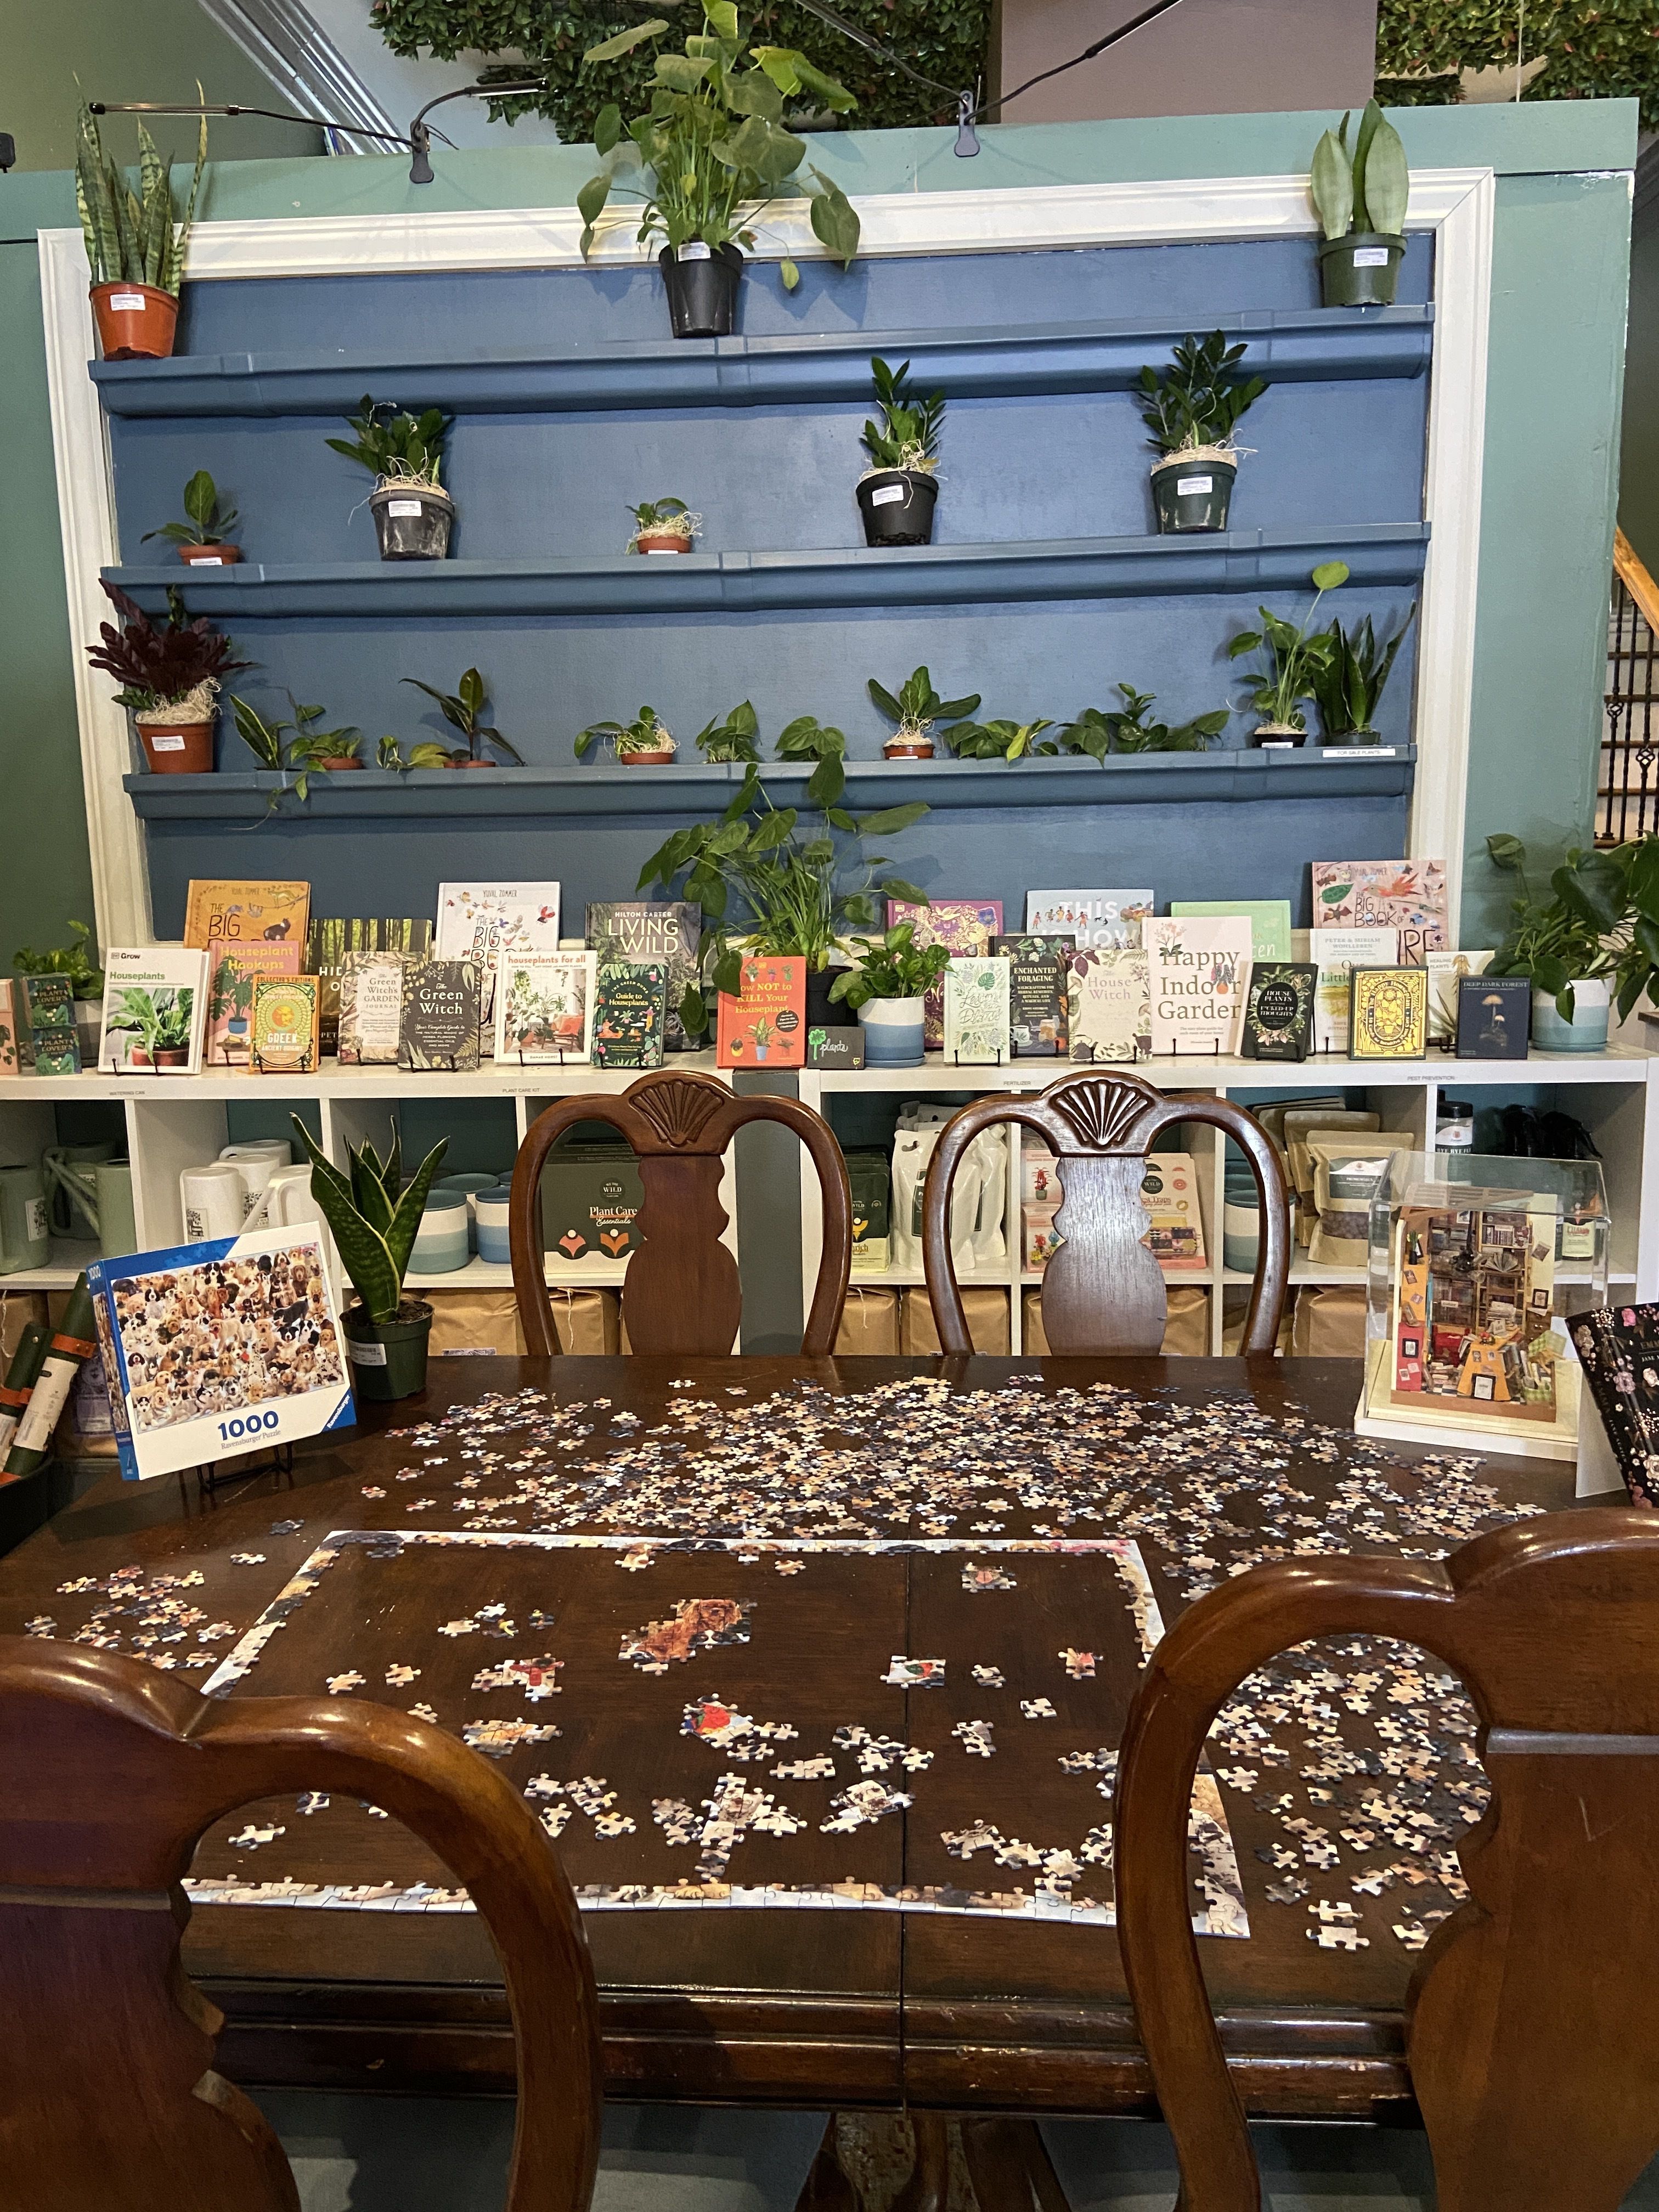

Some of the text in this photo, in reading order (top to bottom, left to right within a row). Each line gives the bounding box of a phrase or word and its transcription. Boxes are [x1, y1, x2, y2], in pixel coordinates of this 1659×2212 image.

[210, 903, 224, 913] THE
[1059, 901, 1118, 919] THIS
[1355, 897, 1374, 912] BIG
[476, 917, 488, 926] THE
[1355, 911, 1397, 928] BOOK
[208, 913, 240, 938] BIG
[607, 918, 679, 936] LIVING
[472, 926, 500, 948] BIG
[620, 936, 679, 953] WILD
[221, 946, 294, 956] Houseplant
[508, 955, 558, 966] houseplants
[576, 955, 586, 963] all
[1161, 947, 1240, 970] Happy
[228, 960, 284, 971] Hookups
[110, 972, 165, 981] Houseplants
[1088, 977, 1132, 987] House
[757, 983, 779, 991] NOT
[420, 989, 464, 1000] Green
[736, 994, 764, 1002] KILL
[1090, 989, 1130, 1000] Witch
[420, 1002, 463, 1014] Witch
[609, 999, 648, 1007] Houseplants
[735, 1005, 789, 1014] Houseplant
[267, 1033, 297, 1043] GREEK
[820, 1039, 848, 1057] plants
[590, 1206, 637, 1216] Plant Care
[596, 1216, 631, 1227] Essentials
[88, 1265, 101, 1280] 1000
[326, 1394, 350, 1429] Ravensburger
[218, 1410, 279, 1441] 1000
[221, 1430, 281, 1449] Ravensburger Puzzle
